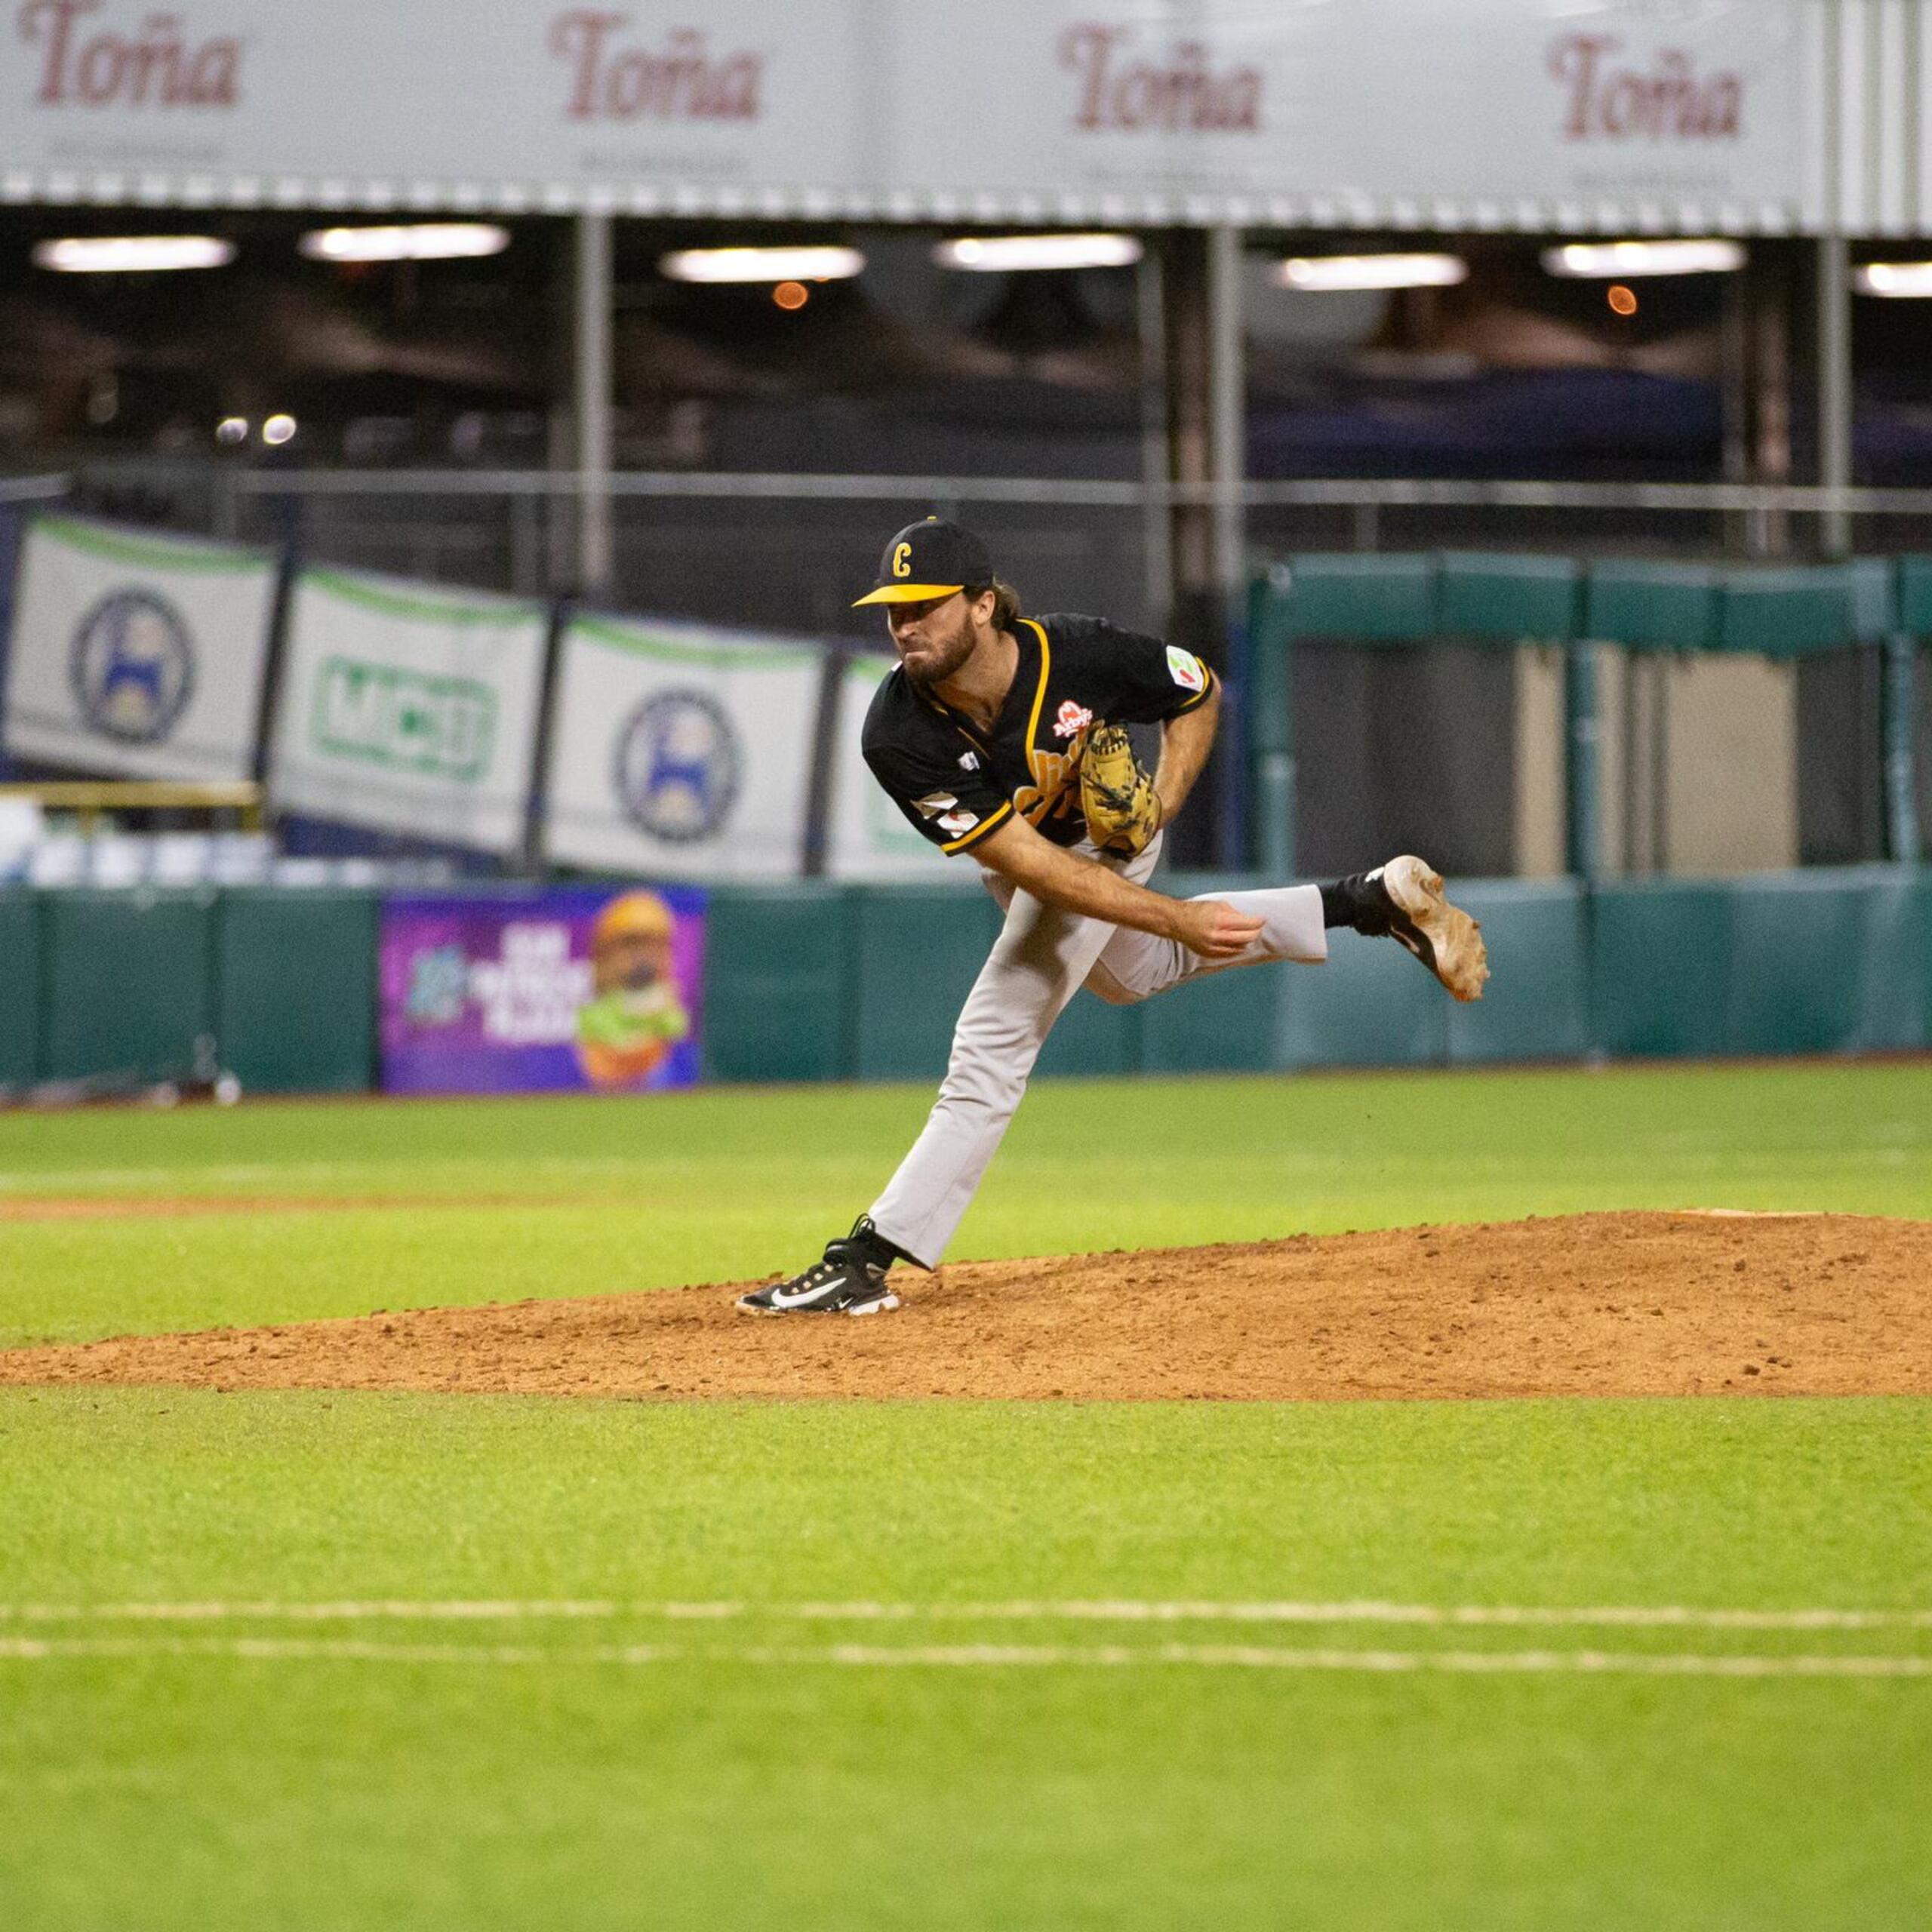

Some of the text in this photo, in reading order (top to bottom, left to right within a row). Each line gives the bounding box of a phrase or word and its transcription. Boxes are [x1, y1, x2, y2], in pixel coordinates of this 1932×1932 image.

[20, 0, 240, 107] Toña
[548, 9, 764, 120] Toña
[1058, 24, 1262, 131] Toña
[1549, 32, 1743, 140] Toña
[893, 542, 912, 578] C
